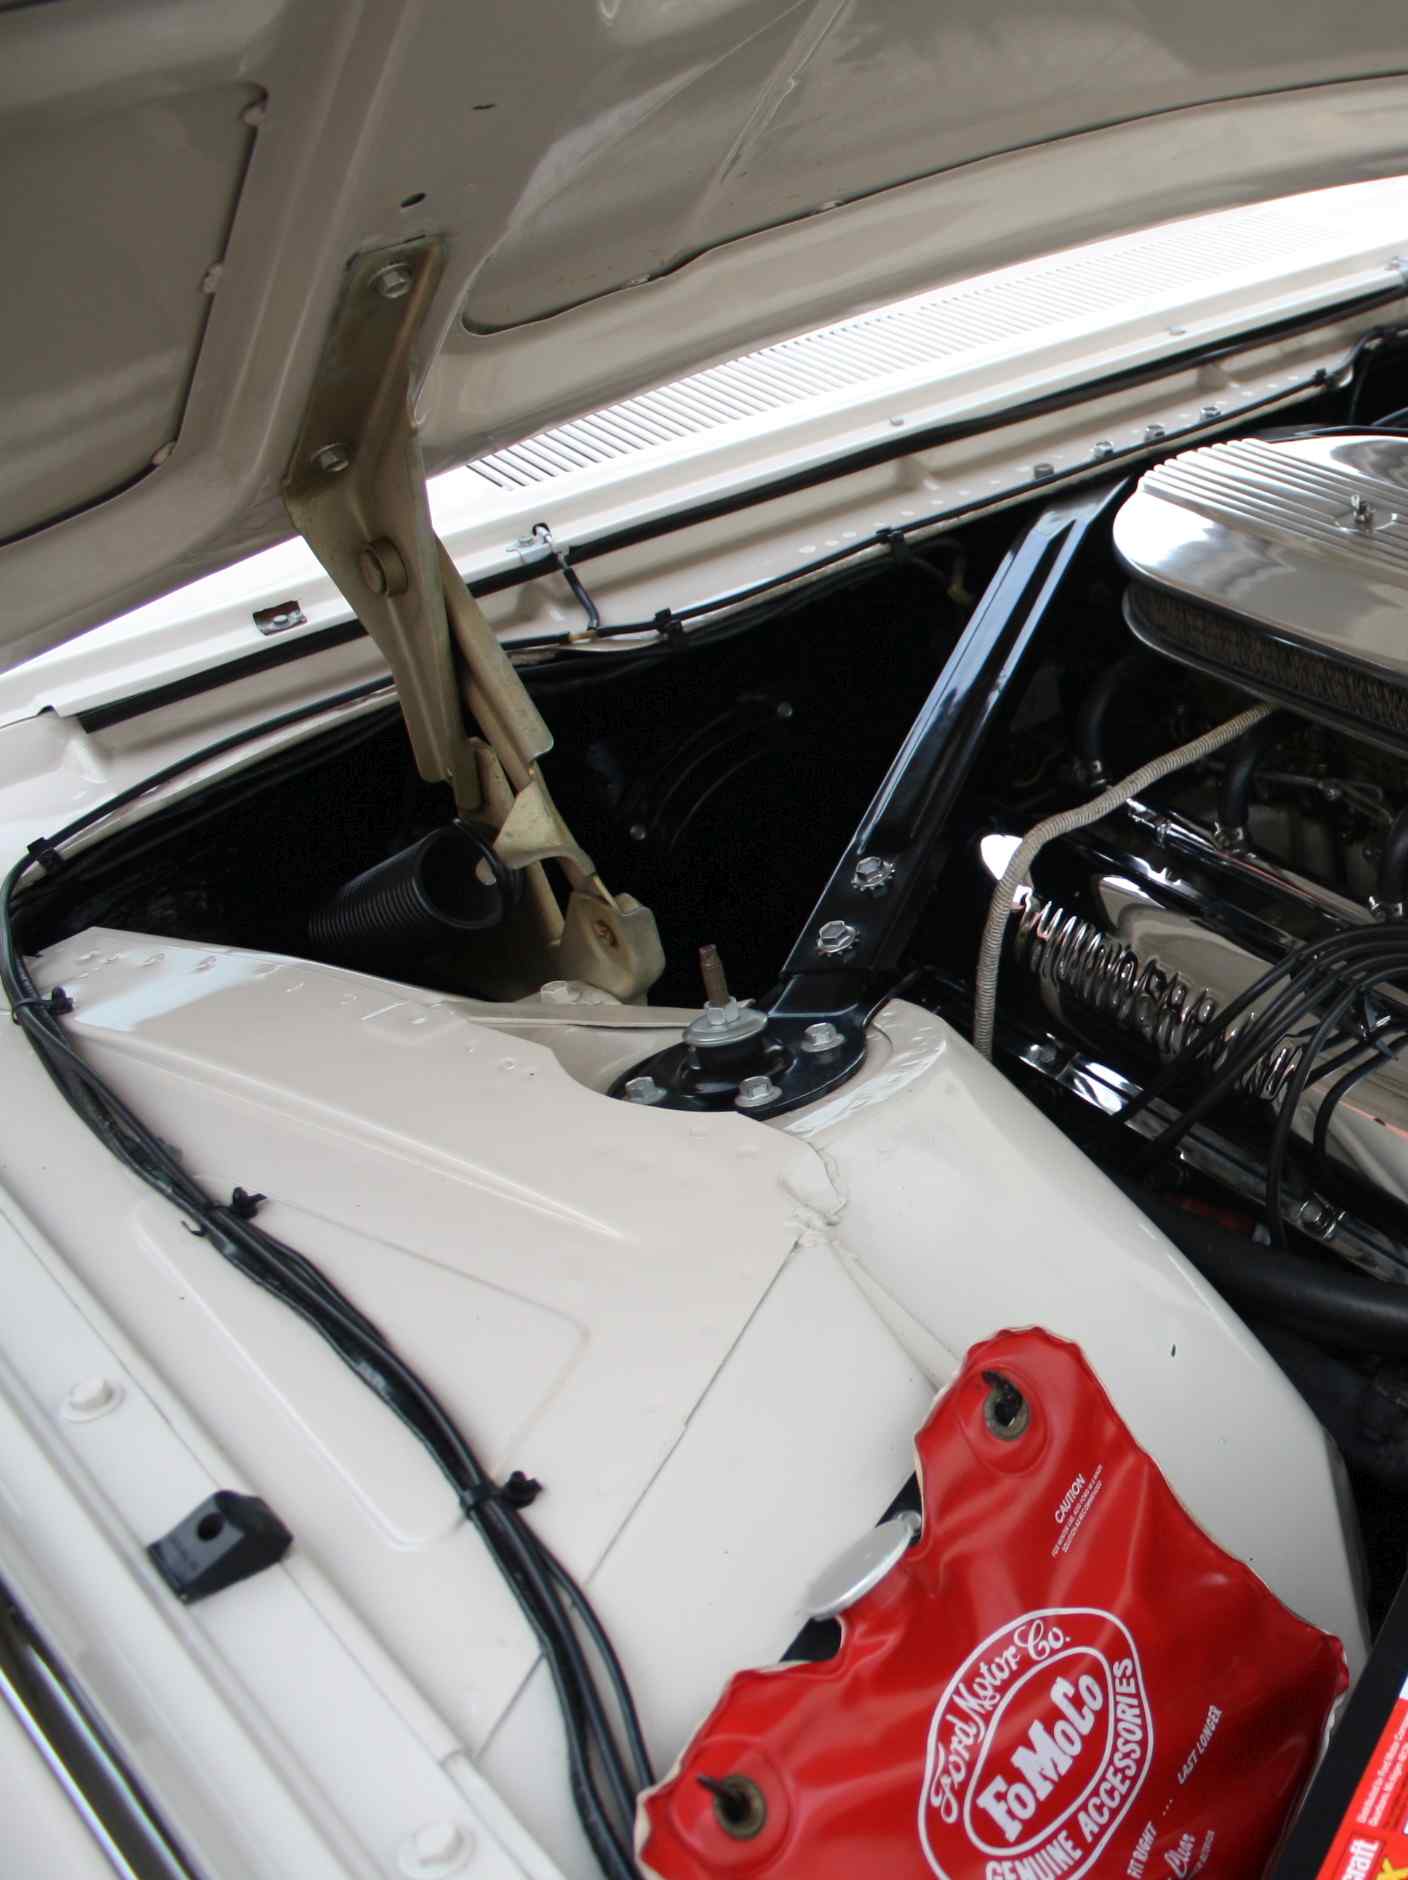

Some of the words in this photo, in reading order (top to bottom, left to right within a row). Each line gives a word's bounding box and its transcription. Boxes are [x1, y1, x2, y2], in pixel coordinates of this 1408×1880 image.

[1055, 1473, 1086, 1523] CAUTION
[952, 1645, 1021, 1744] Motor
[1013, 1620, 1071, 1660] Co.
[930, 1713, 977, 1824] Ford
[976, 1671, 1103, 1842] FoMoCo
[985, 1829, 1082, 1880] GENUINE
[1078, 1656, 1143, 1842] ACCESSORIES
[1133, 1820, 1157, 1863] RIGHT
[1177, 1749, 1199, 1784] LAST
[1196, 1705, 1222, 1753] LONGER
